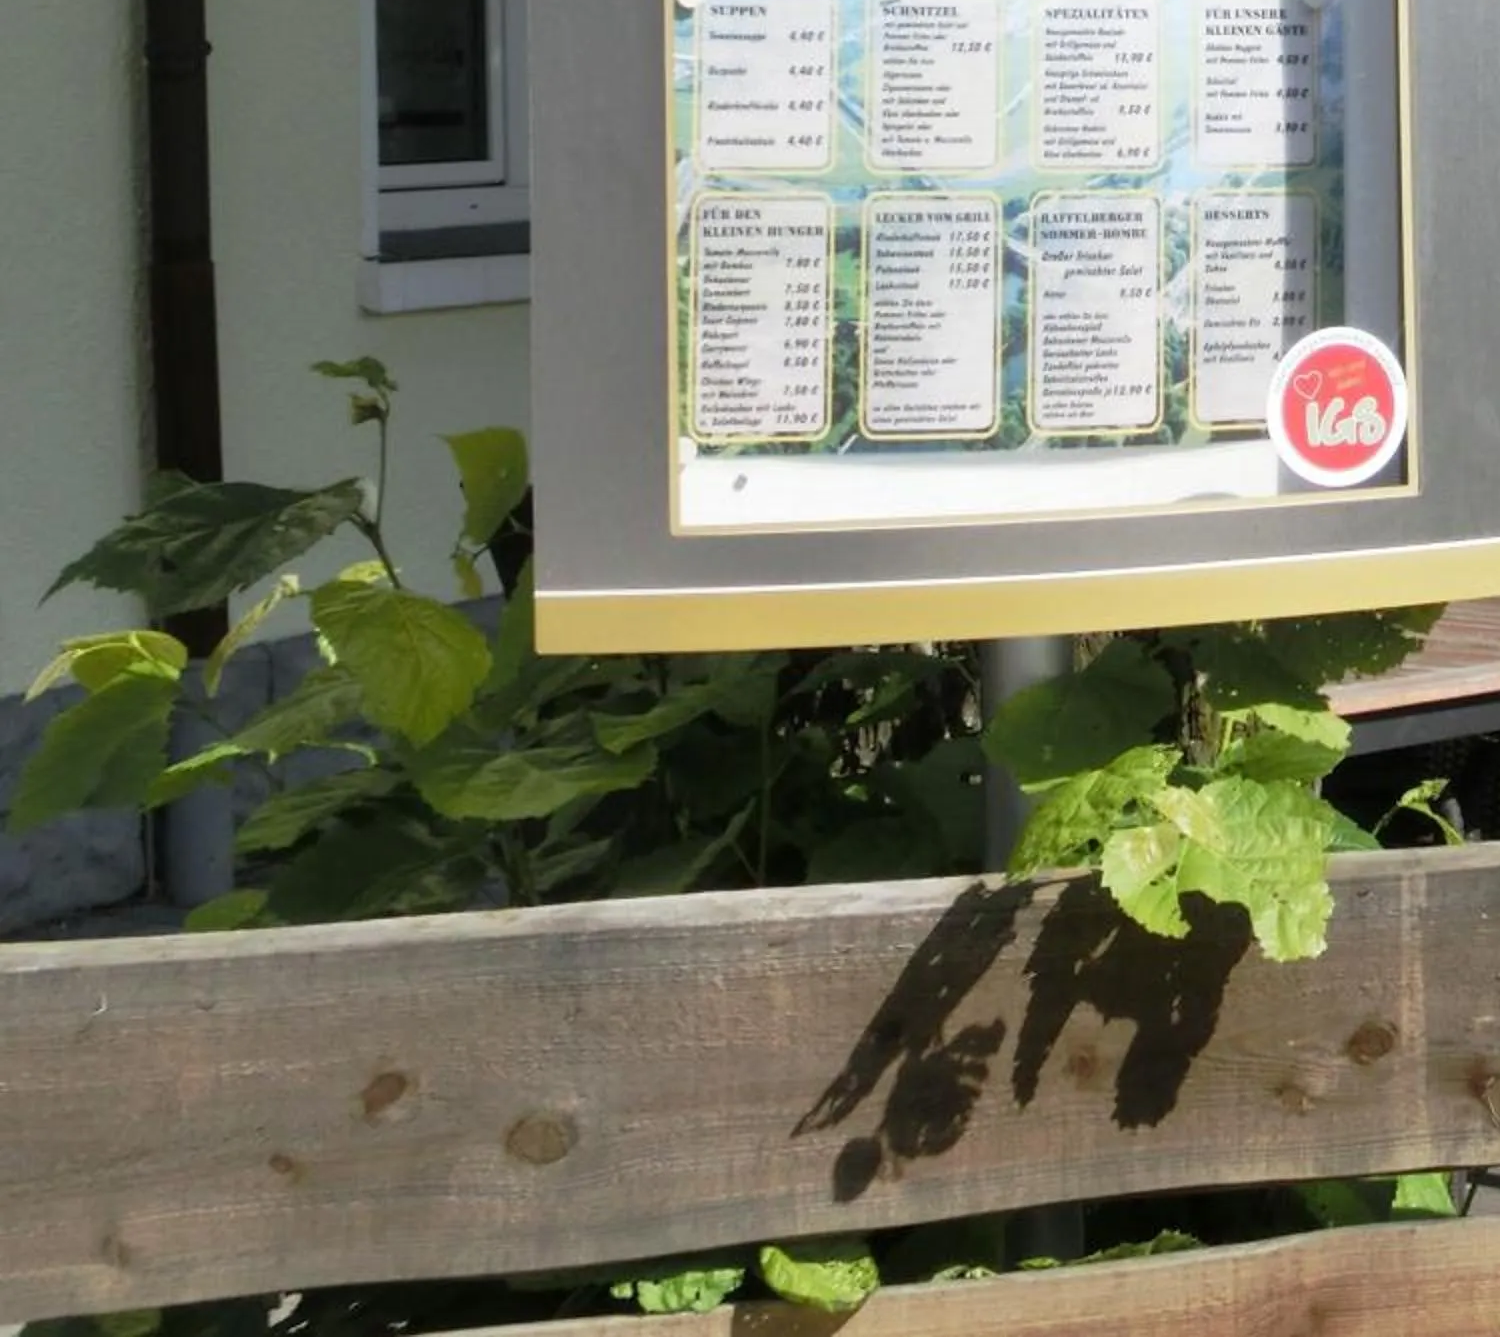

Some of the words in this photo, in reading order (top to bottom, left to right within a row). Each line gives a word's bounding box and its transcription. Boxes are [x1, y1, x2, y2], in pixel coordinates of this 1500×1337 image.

[710, 5, 767, 16] SUPPEN
[883, 6, 959, 17] SCHNITZEL
[1045, 5, 1149, 19] SPEZIALITÄTEN
[1205, 5, 1232, 19] FÜR
[1234, 8, 1288, 19] UNSERE
[1205, 24, 1262, 36] KLEINEN
[703, 205, 731, 220] FÜR
[735, 209, 761, 220] DEN
[875, 212, 924, 224] LECKER
[926, 212, 953, 224] VOM
[955, 212, 991, 224] GRILL
[1041, 211, 1144, 224] RAFFELBERGER
[1204, 209, 1270, 221] DESSERTS
[703, 226, 763, 237] KLEINEN
[767, 226, 825, 237] HUNGER
